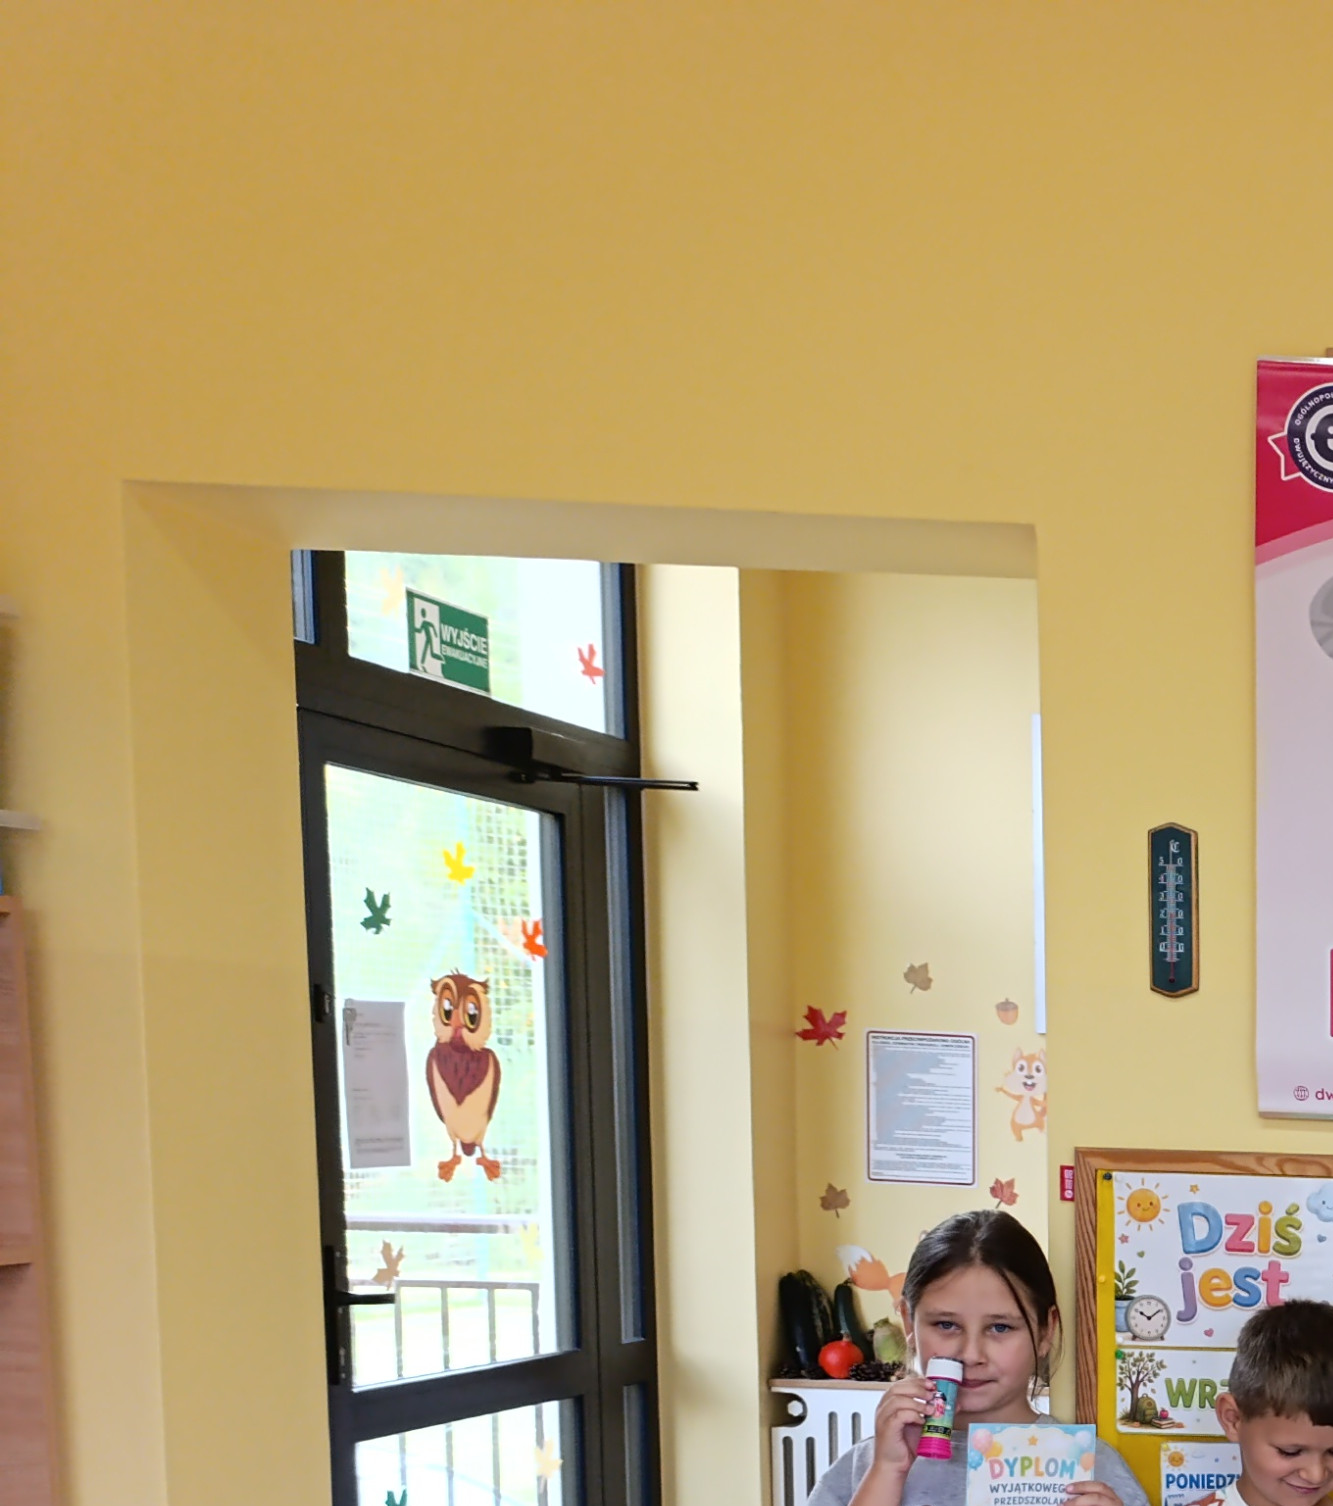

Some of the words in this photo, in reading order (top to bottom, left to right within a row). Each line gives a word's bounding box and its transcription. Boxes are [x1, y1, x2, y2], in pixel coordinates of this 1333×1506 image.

[441, 623, 488, 654] WYJŚCIE
[1176, 1200, 1303, 1257] Dziś
[1175, 1256, 1290, 1324] jest
[988, 1455, 1076, 1480] DYPLOM
[1165, 1472, 1241, 1490] PONIEDZ
[989, 1482, 1067, 1495] WYJĄTKOWEG
